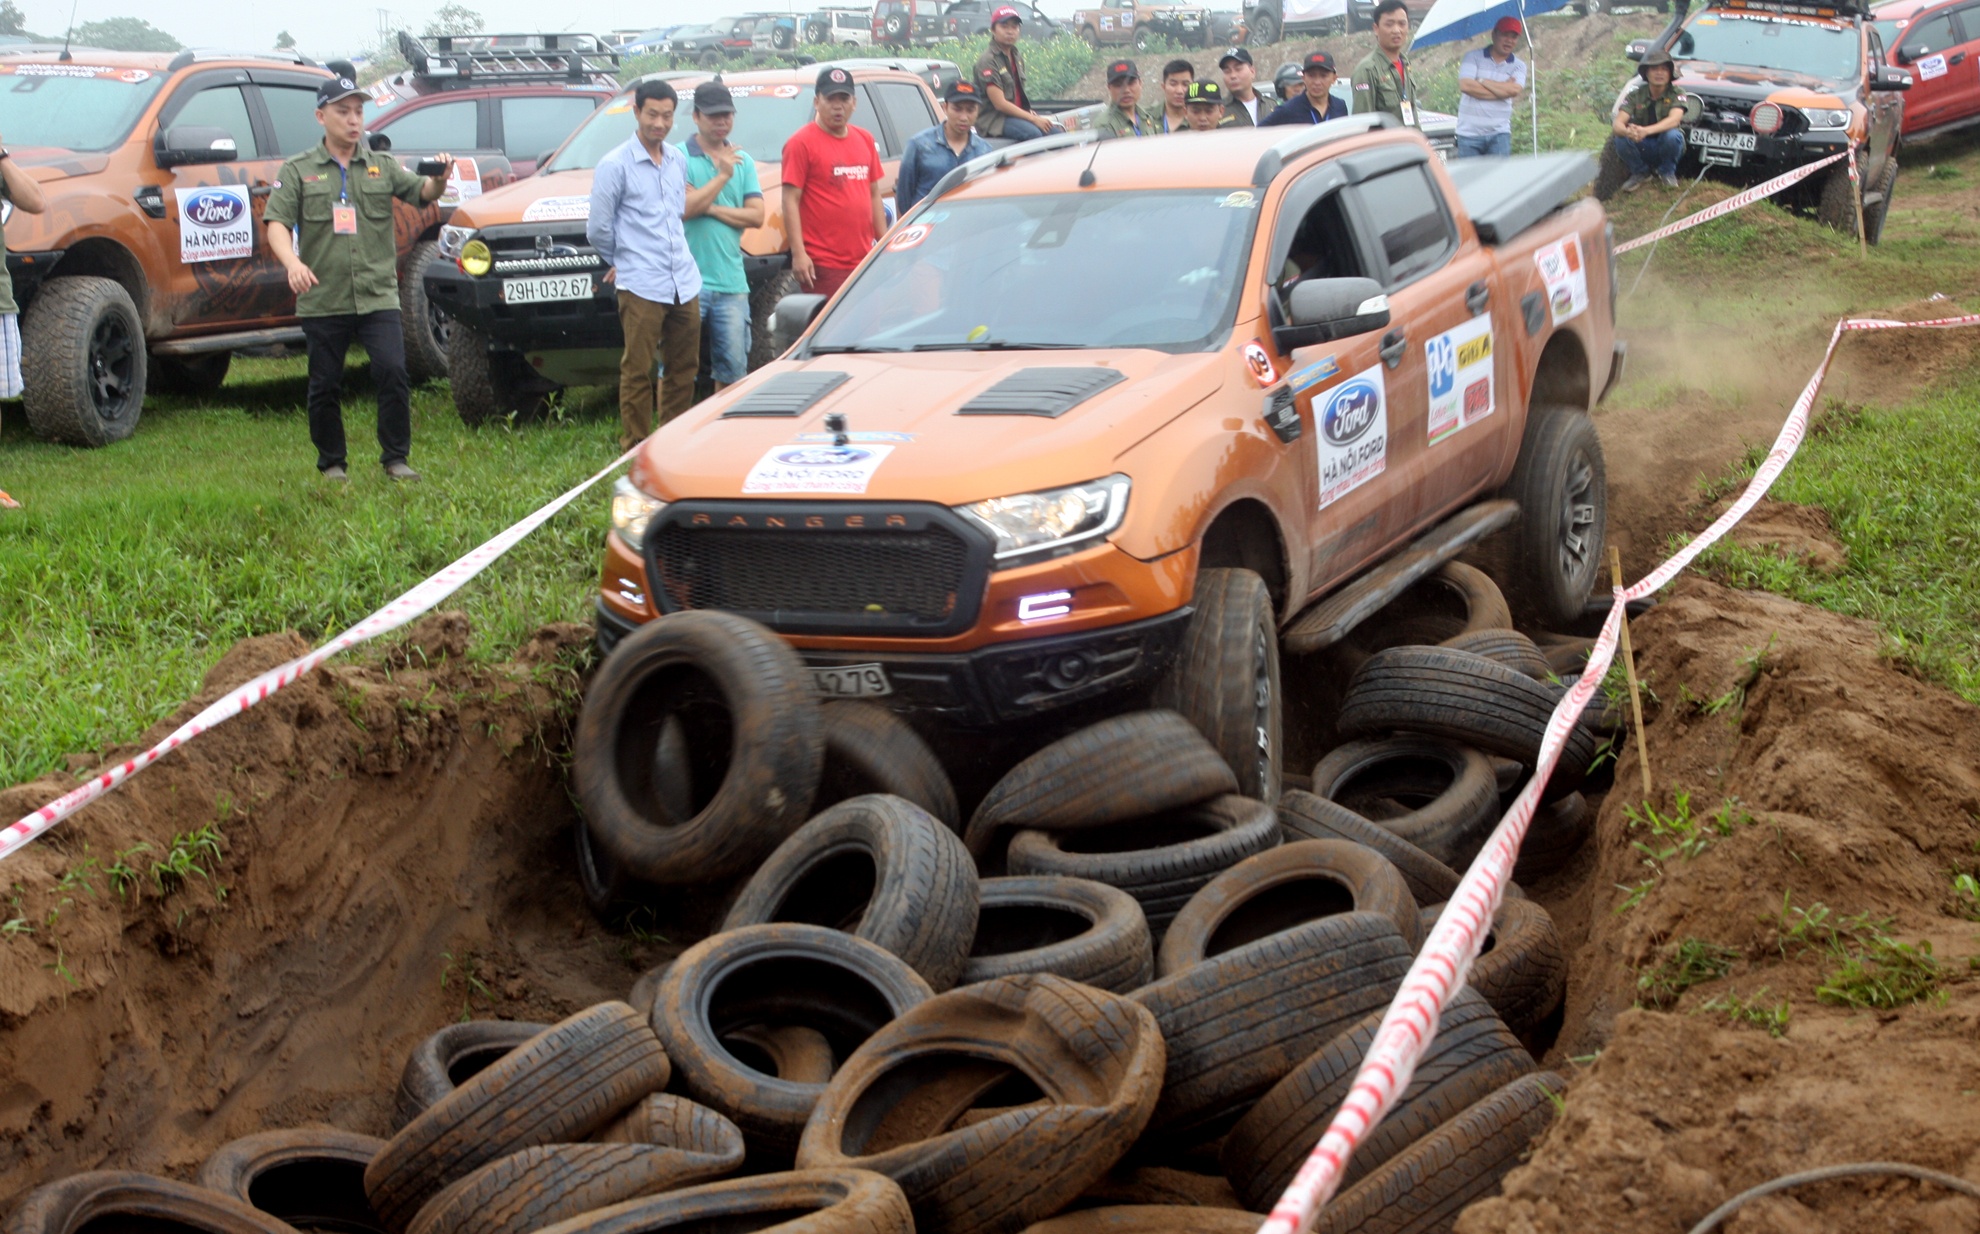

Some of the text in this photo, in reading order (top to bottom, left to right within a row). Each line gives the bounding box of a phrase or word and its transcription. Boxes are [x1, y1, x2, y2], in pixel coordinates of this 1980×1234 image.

[1742, 14, 1769, 22] THE
[1771, 16, 1819, 27] BEAST
[197, 194, 234, 222] Ford
[185, 229, 249, 249] HÀ NỘI FORD
[894, 230, 923, 244] 09
[506, 278, 589, 301] 29H-032.67
[1248, 350, 1269, 376] 09
[1333, 389, 1370, 439] Ford
[1323, 434, 1384, 486] HÀ NỘI FORD
[692, 513, 906, 528] RANGER
